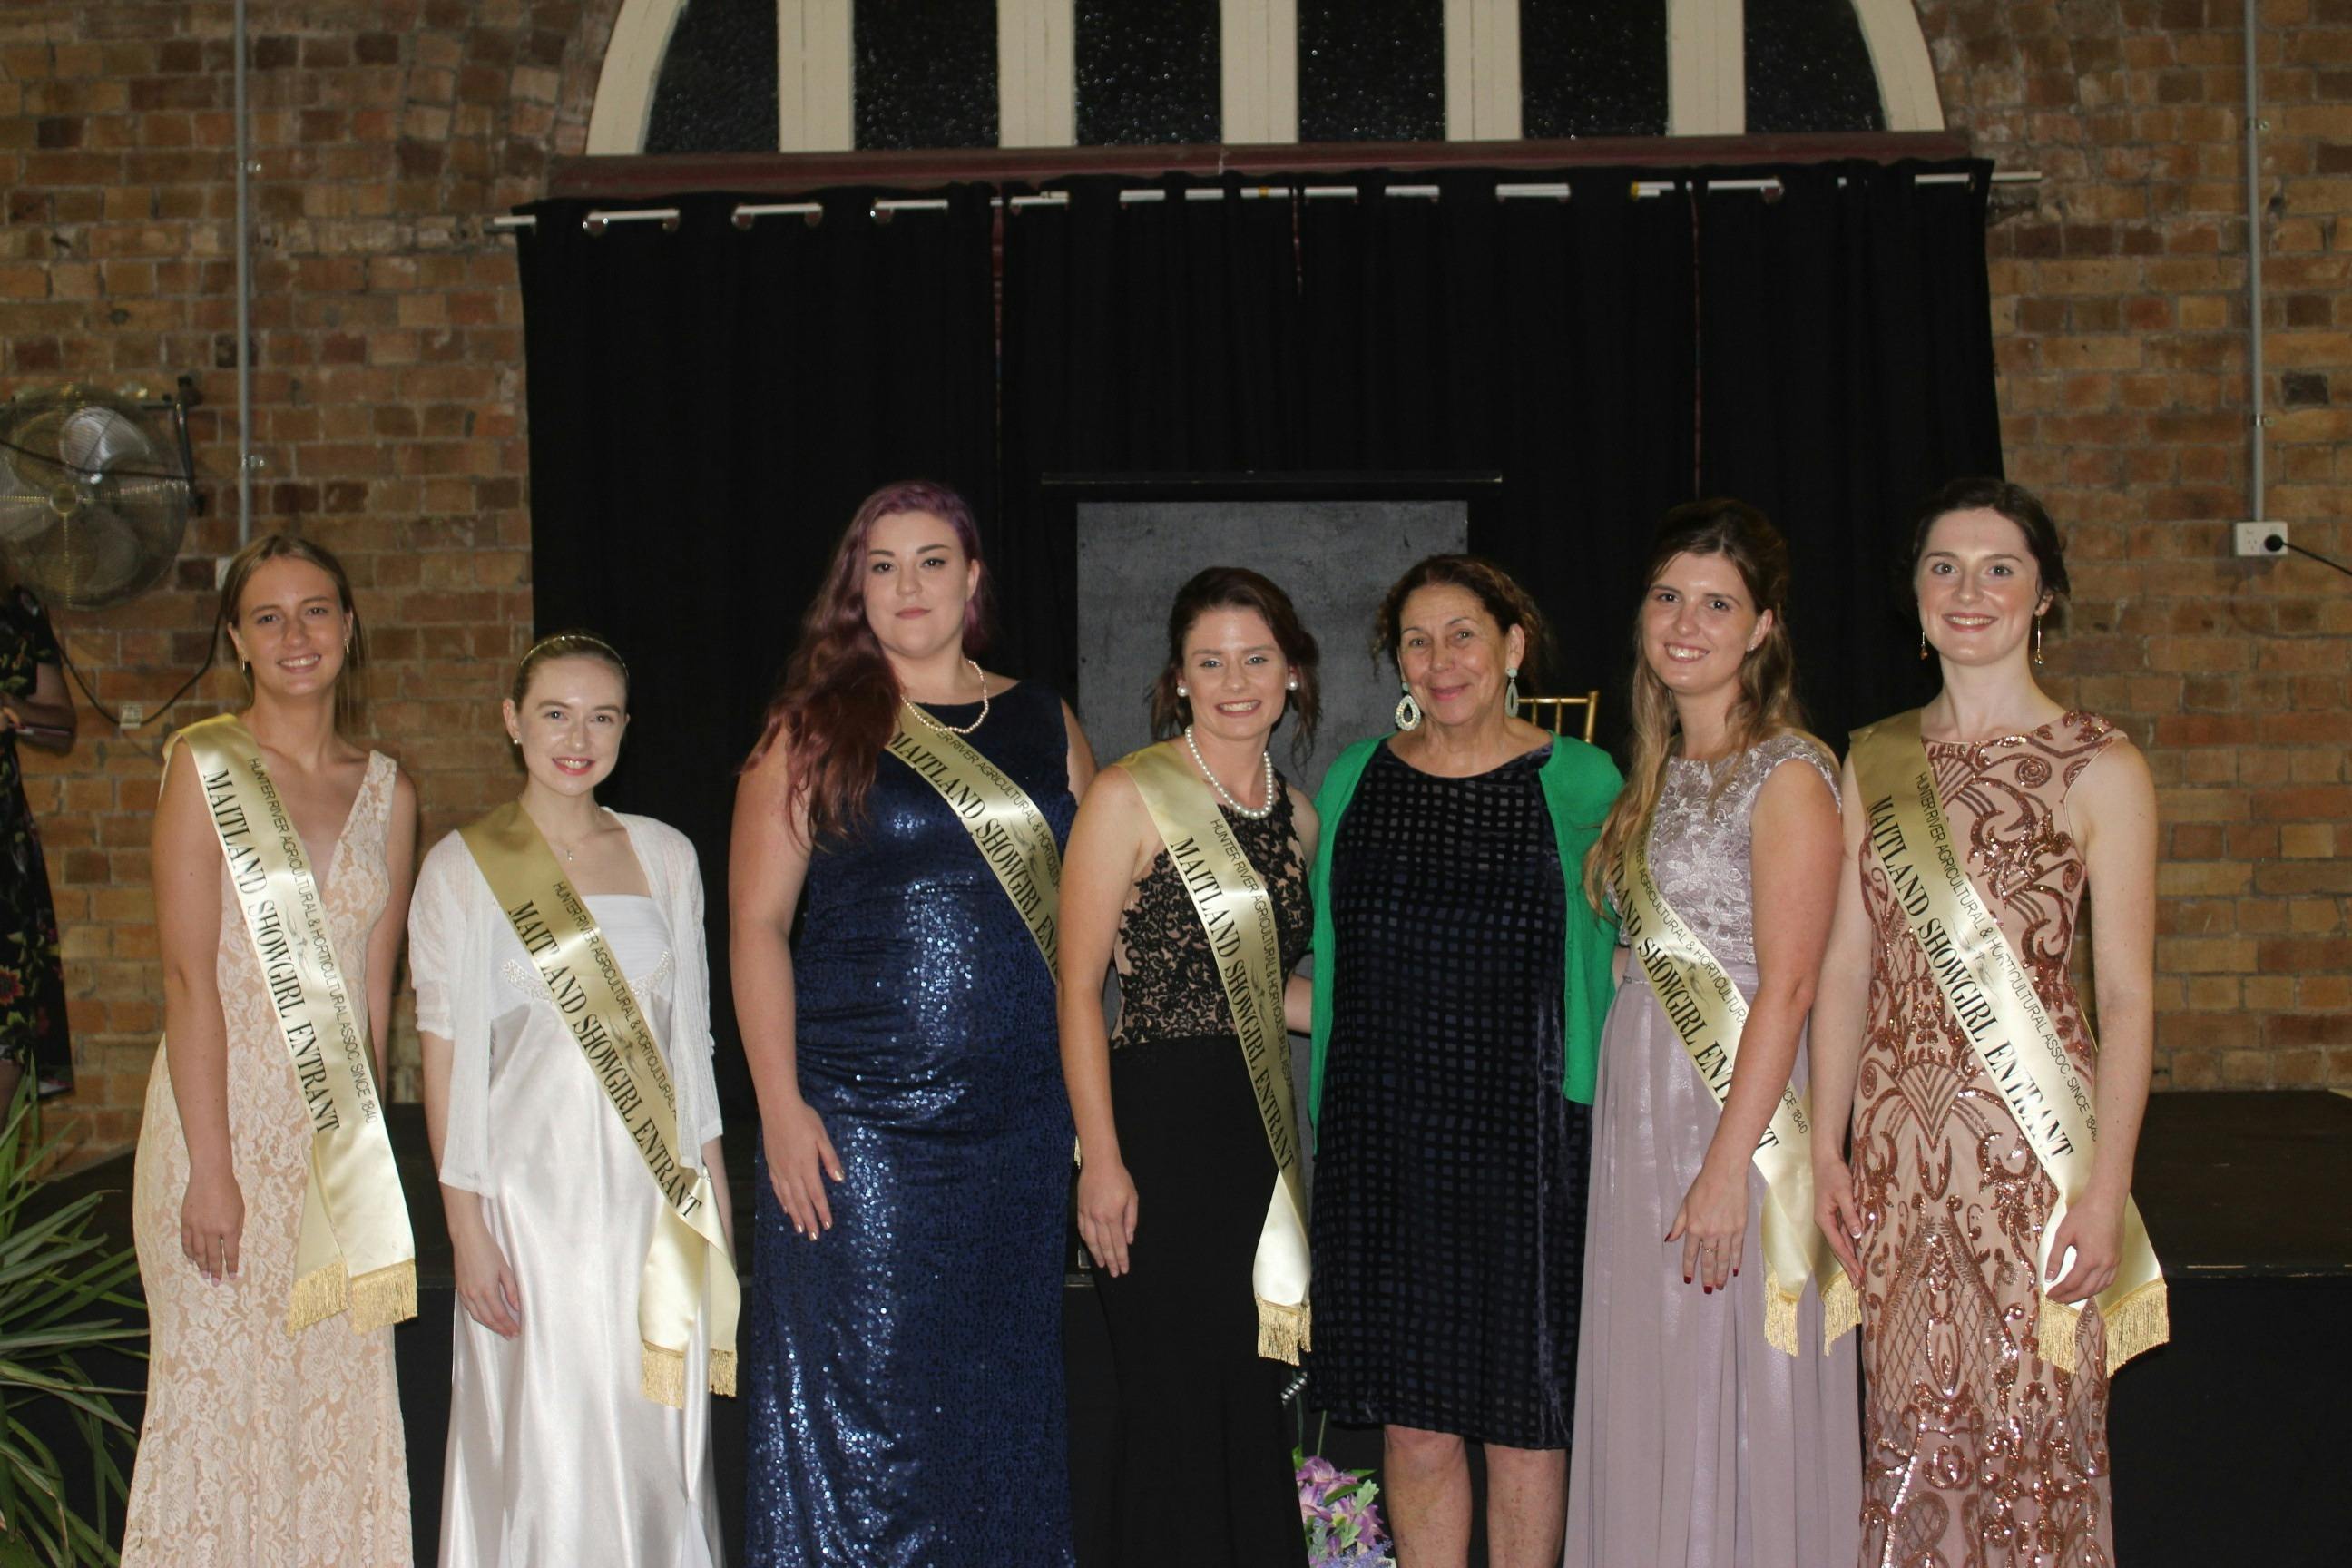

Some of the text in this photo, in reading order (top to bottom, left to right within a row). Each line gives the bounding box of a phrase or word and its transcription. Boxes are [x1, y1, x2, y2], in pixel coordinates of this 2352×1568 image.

[248, 757, 276, 800] HUNTER
[951, 740, 980, 763] RIVER
[267, 799, 289, 834] RIVER
[1915, 771, 1936, 812] HUNTER
[1925, 809, 1945, 845] RIVER
[279, 836, 318, 918] AGRICULTURAL
[553, 881, 583, 921] HUNTER
[975, 818, 1042, 922] SHOWGIRL
[1210, 818, 1240, 862] HUNTER
[1234, 861, 1259, 893] RIVER
[1251, 895, 1277, 970] AGRICULTURAL
[1935, 843, 1985, 929] AGRICULTURAL
[203, 769, 340, 1133] MAITLAND SHOWGIRL ENTRANT
[309, 918, 321, 928] &
[1867, 794, 1930, 916] MAITLAND
[1917, 917, 1998, 1043] SHOWGIRL
[1979, 926, 1994, 939] &
[310, 927, 349, 1021] HORTICULTURAL
[592, 946, 635, 1022] AGRICULTURAL
[1170, 835, 1295, 1171] MAITLAND SHOWGIRL ENTRANT
[1637, 937, 1708, 1046] SHOWGIRL
[1639, 867, 1687, 944] AGRICULTURAL
[1686, 940, 1696, 951] &
[1693, 949, 1746, 1025] HORTICULTUR
[1791, 1108, 1808, 1134] 1840
[1985, 936, 2048, 1034] HORTICULTURAL
[630, 1019, 641, 1030] &
[350, 1063, 372, 1099] SINCE
[633, 1028, 677, 1108] HORTICULTURAL
[2066, 1076, 2090, 1115] SINCE
[362, 1099, 378, 1125] 1840
[572, 1013, 643, 1123] SHOWGIRL
[633, 1117, 703, 1218] ENTRANT
